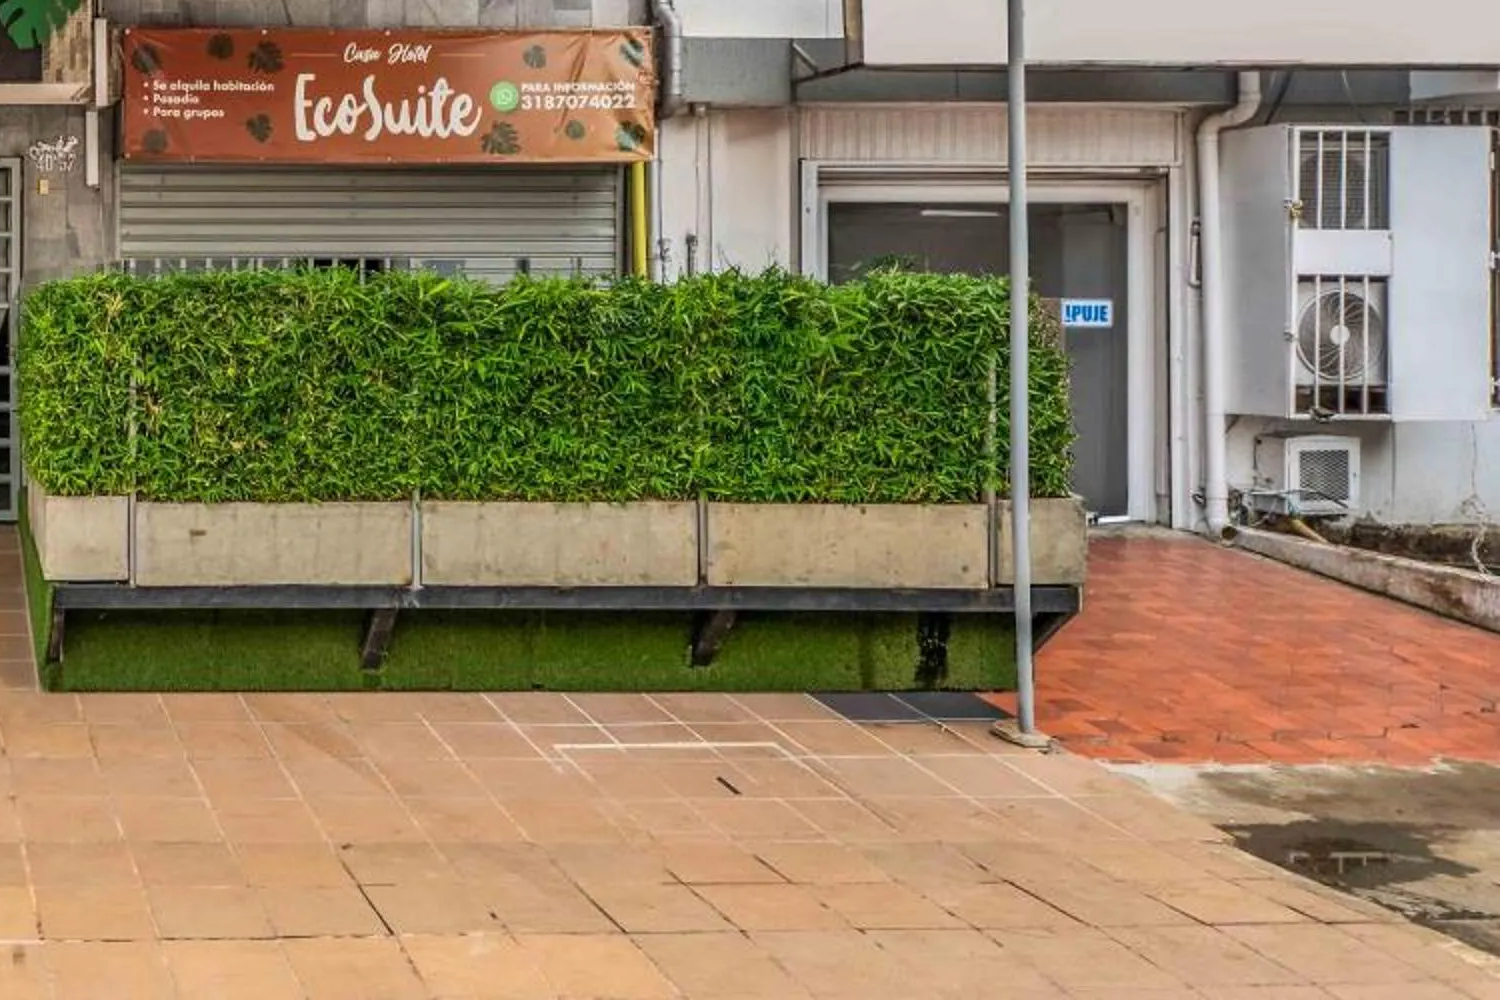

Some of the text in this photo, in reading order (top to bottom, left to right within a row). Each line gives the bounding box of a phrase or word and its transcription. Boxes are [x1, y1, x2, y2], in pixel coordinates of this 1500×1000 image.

[152, 80, 167, 91] Se
[294, 73, 483, 141] EcoSuite
[521, 94, 637, 110] 3187074022
[152, 107, 225, 120] Para grupos
